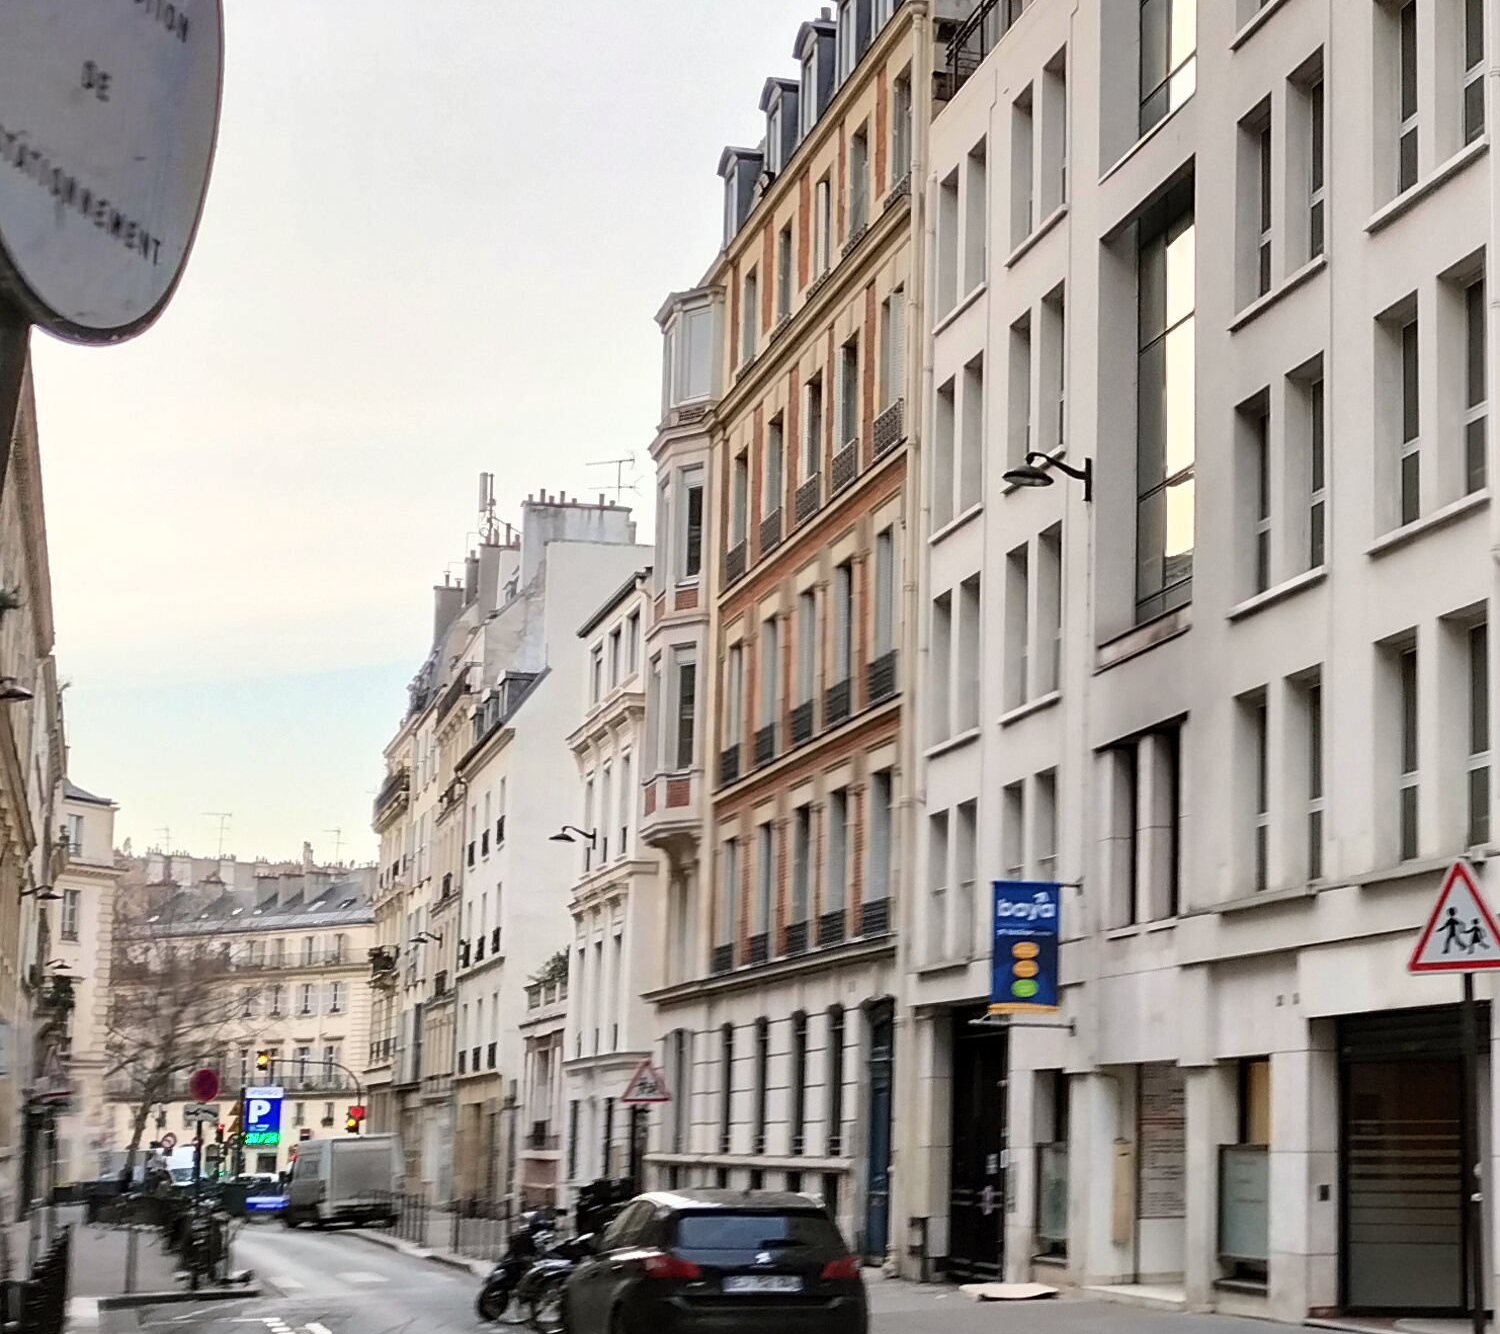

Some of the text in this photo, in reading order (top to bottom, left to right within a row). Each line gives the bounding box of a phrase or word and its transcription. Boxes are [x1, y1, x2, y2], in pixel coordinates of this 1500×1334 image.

[81, 60, 113, 103] DE
[0, 123, 162, 268] TATIONNEMENT
[248, 1099, 271, 1124] P
